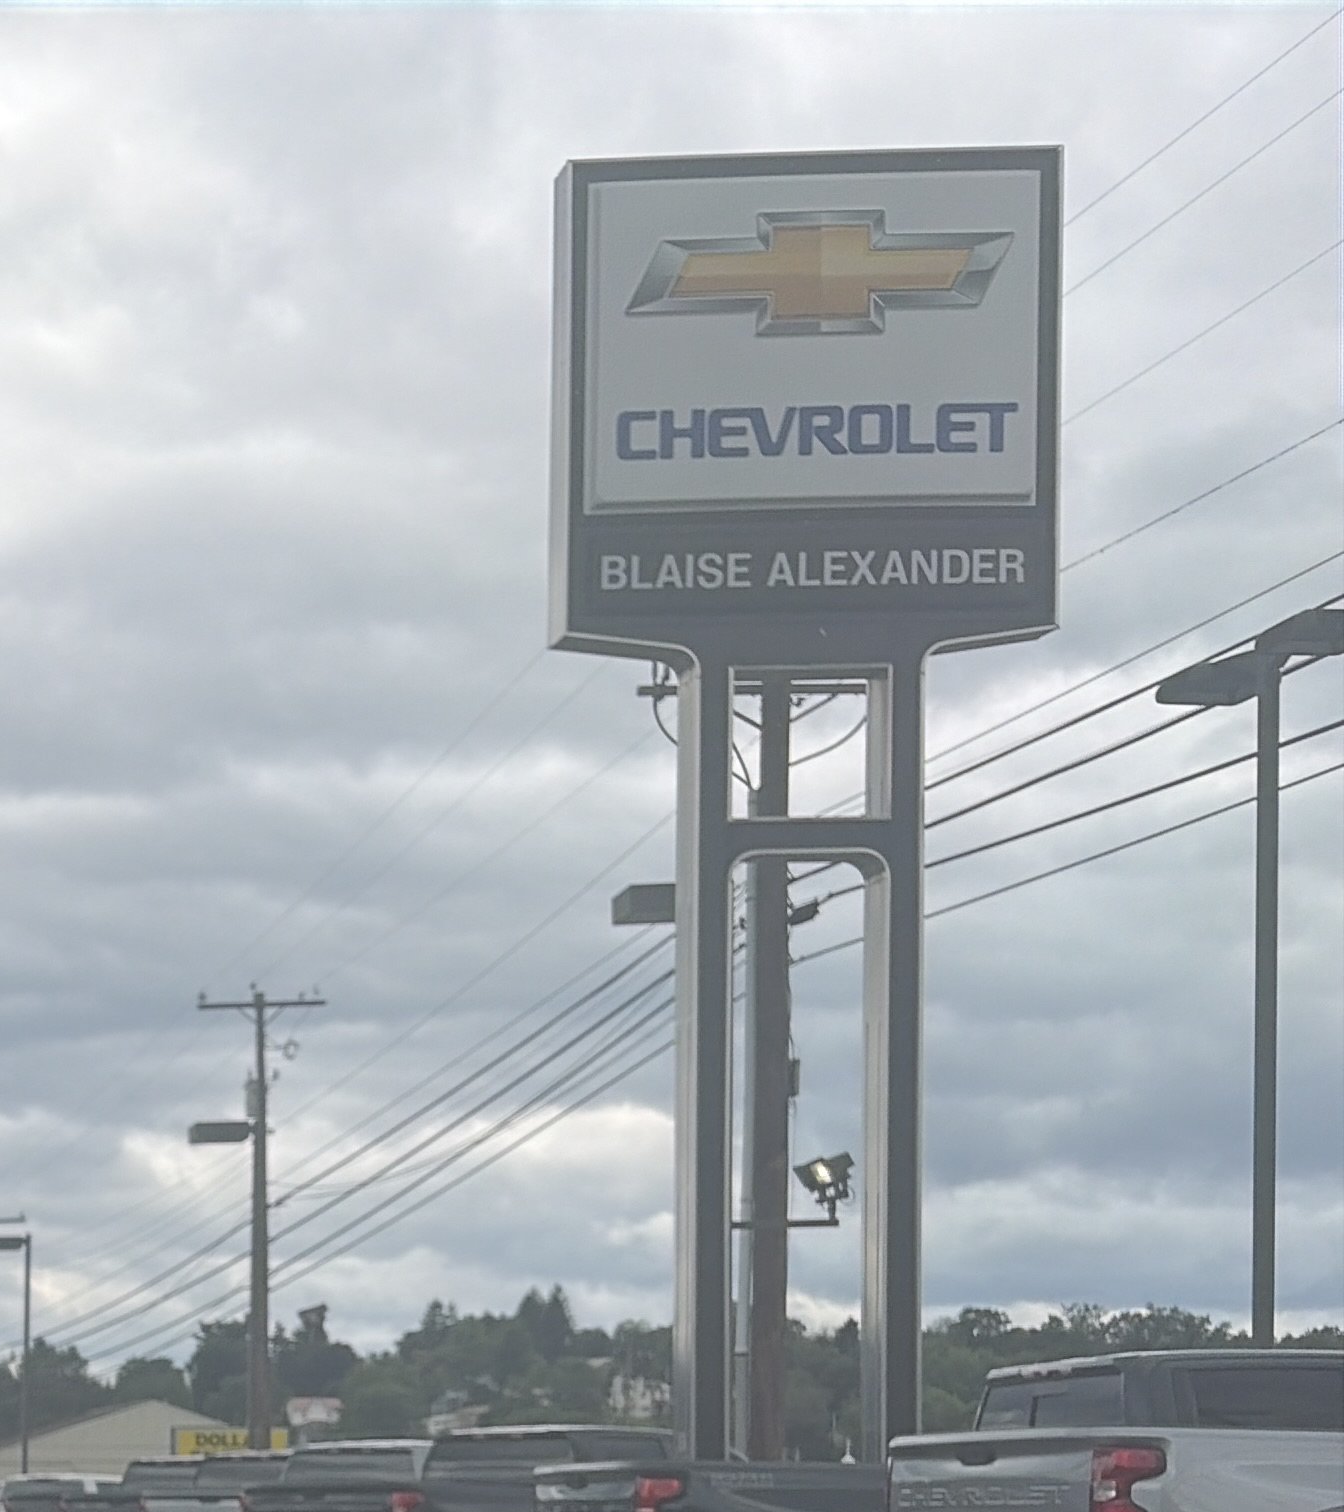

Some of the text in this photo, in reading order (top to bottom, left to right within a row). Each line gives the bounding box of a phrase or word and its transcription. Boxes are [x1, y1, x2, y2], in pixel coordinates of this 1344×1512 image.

[616, 402, 1019, 461] CHEVROLET
[601, 548, 1026, 590] BLAISE ALEXANDER
[897, 1484, 1071, 1508] CHEVROLET
